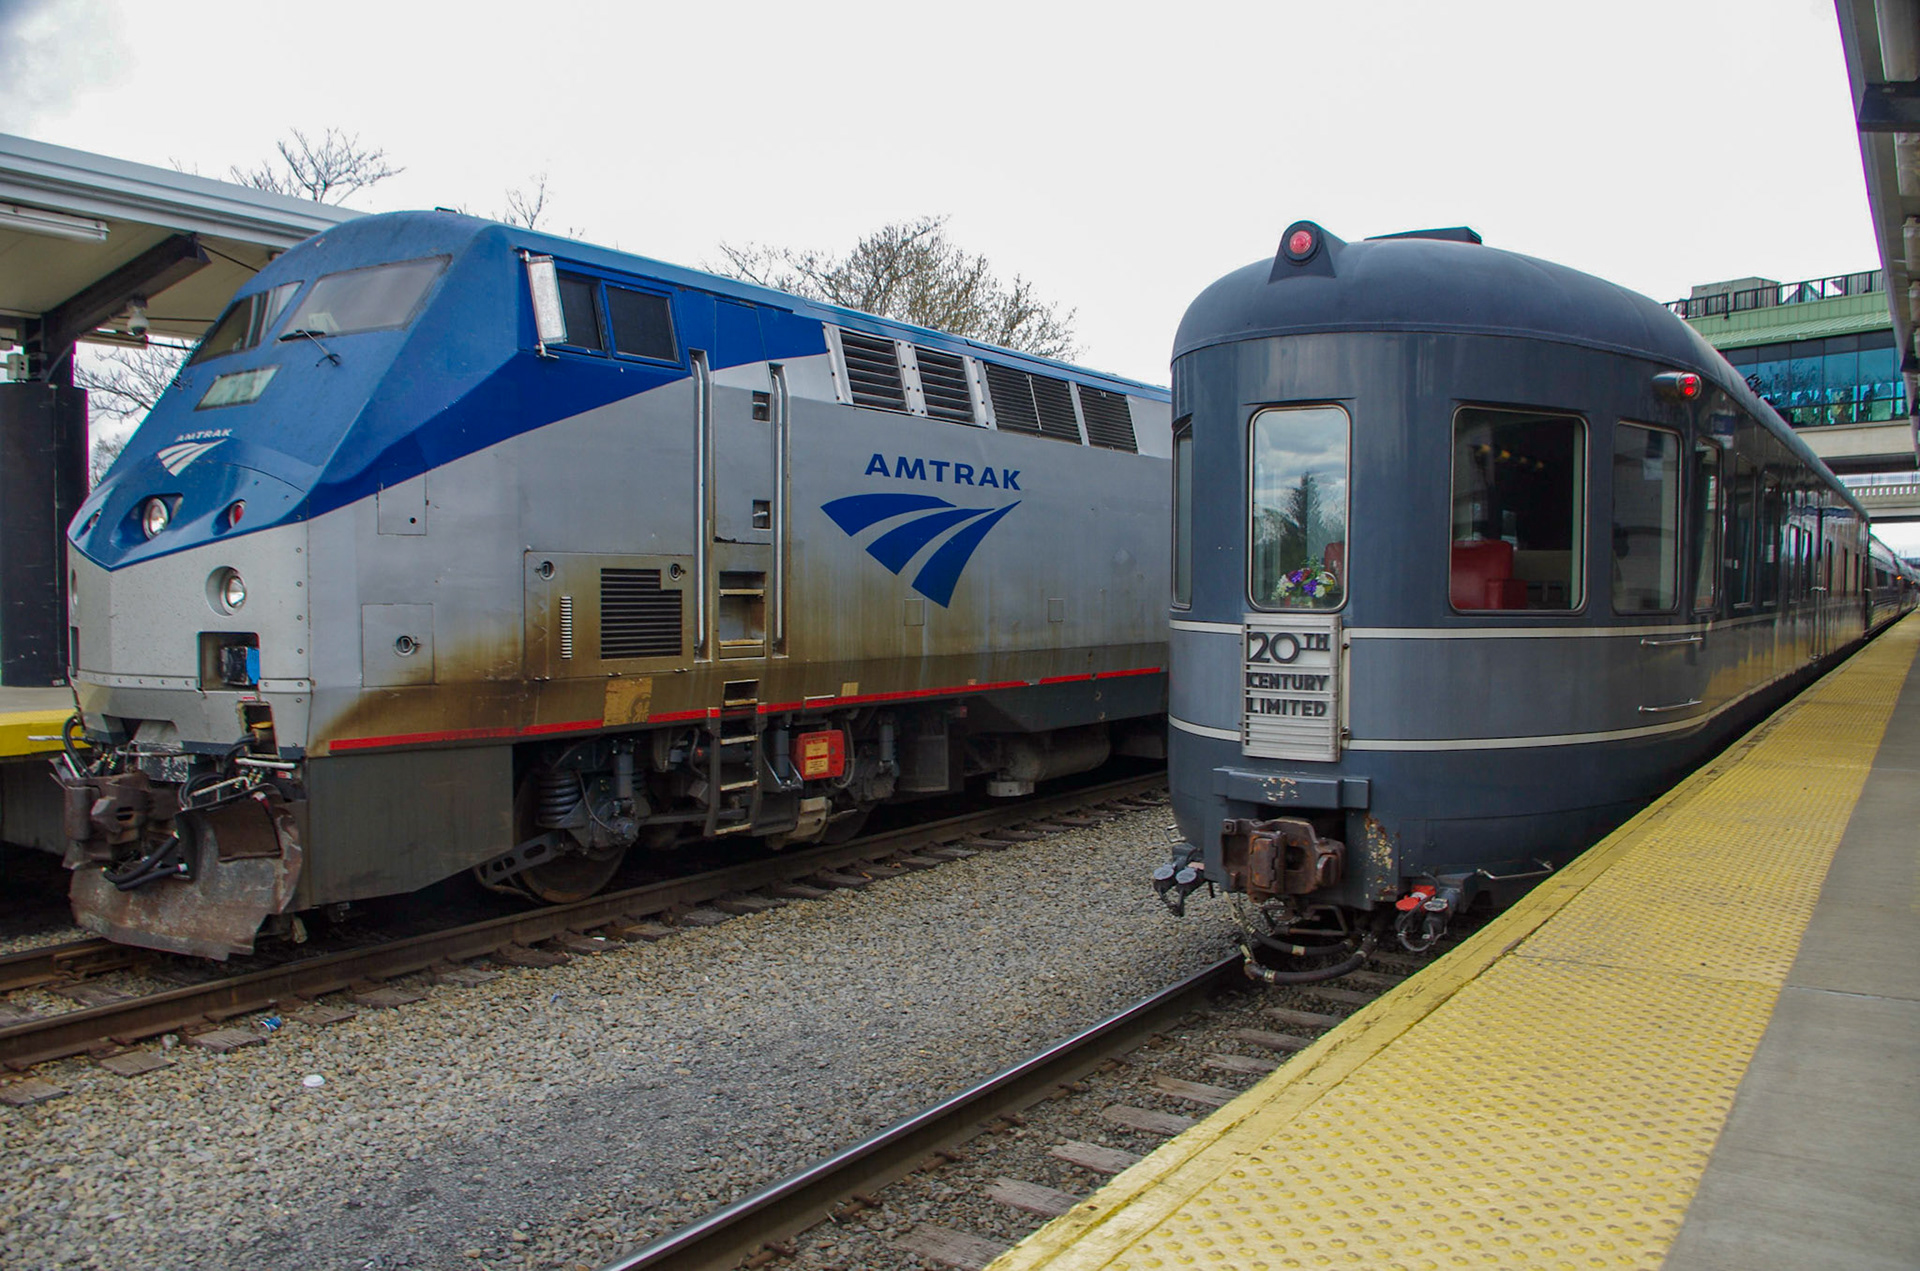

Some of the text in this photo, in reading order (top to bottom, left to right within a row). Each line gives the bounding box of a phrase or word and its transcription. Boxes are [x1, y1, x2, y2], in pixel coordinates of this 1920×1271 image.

[174, 428, 233, 442] AMTRAK
[864, 453, 1022, 491] AMTRAK
[1248, 631, 1331, 664] 20TH
[1247, 673, 1330, 692] CENTURY
[1247, 697, 1328, 717] LIMITED
